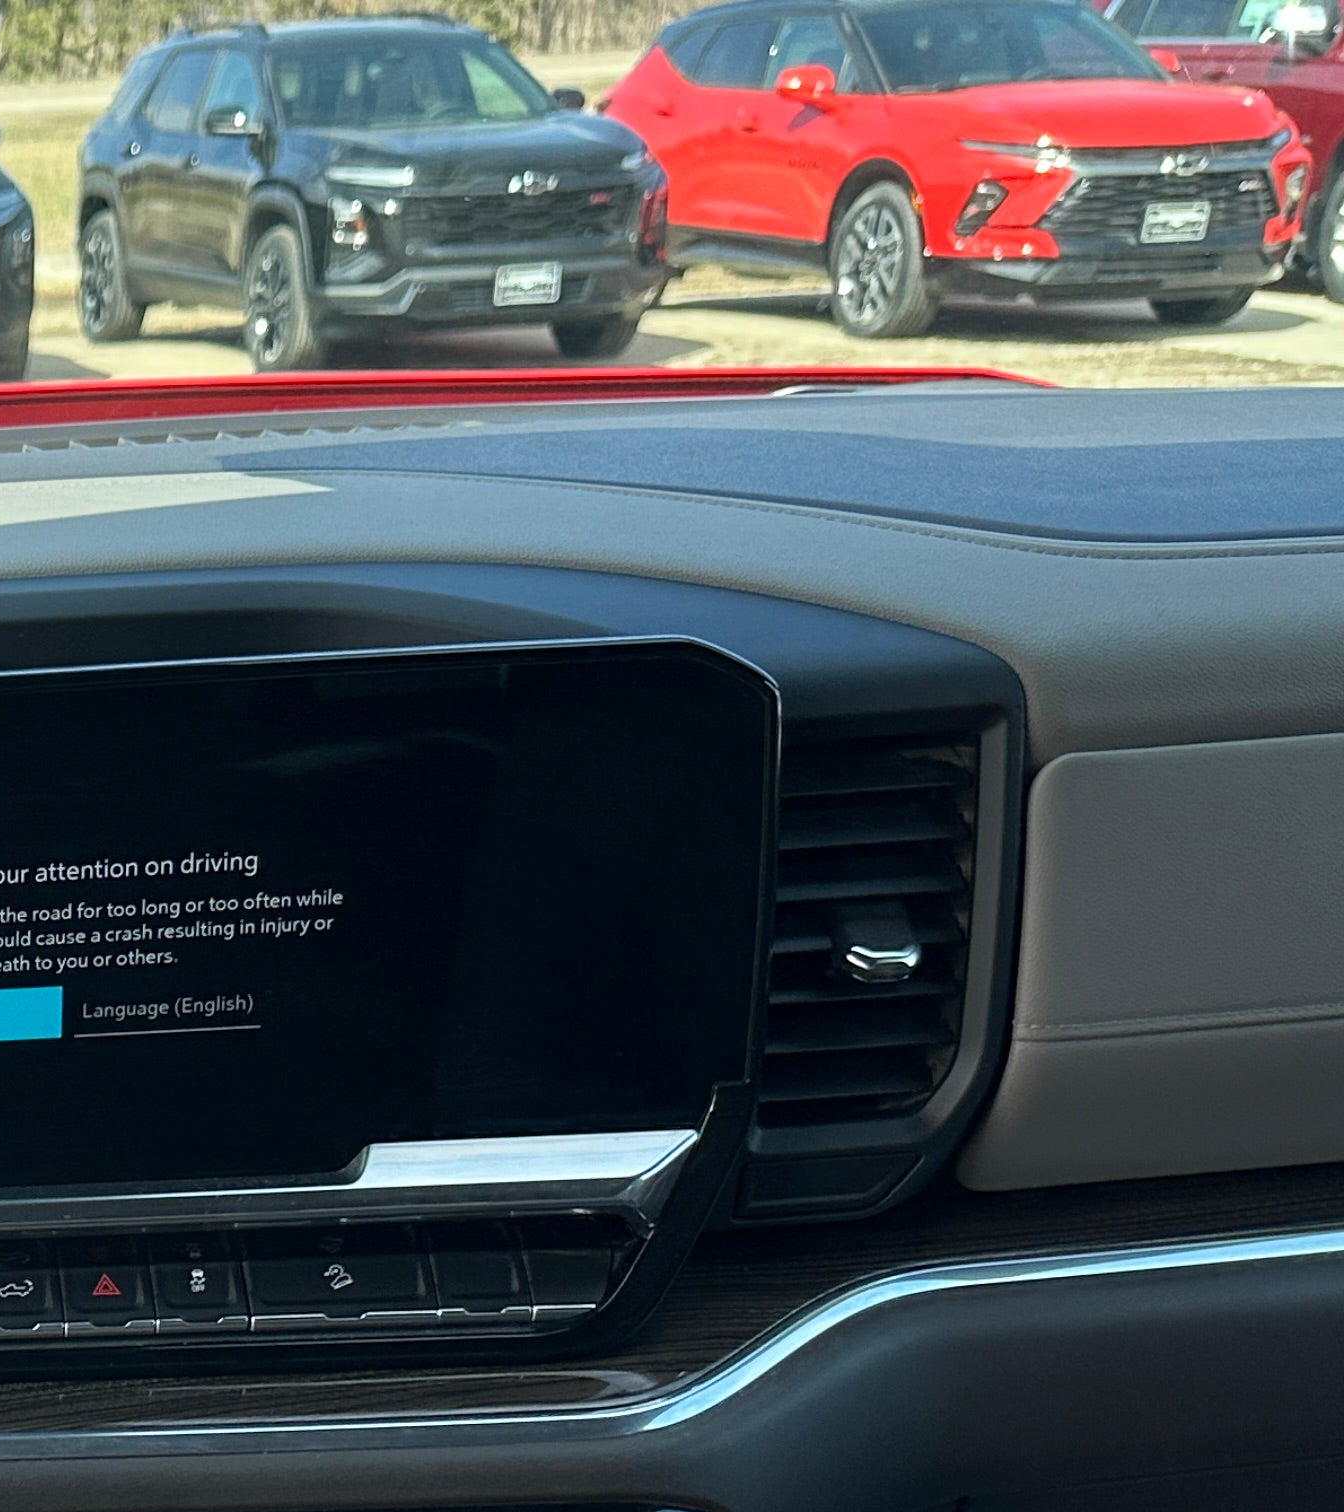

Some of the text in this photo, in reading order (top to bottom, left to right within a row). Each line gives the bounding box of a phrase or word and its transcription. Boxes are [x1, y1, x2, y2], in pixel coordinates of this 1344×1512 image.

[34, 858, 138, 883] attention
[144, 858, 174, 876] on
[180, 852, 259, 877] driving
[0, 906, 28, 924] the
[31, 903, 72, 922] road
[76, 902, 103, 919] for
[106, 902, 137, 918] too
[141, 899, 181, 919] long
[185, 900, 205, 913] or
[208, 896, 239, 912] too
[243, 891, 292, 910] often
[296, 888, 344, 907] while
[35, 930, 87, 947] cause
[90, 930, 101, 944] a
[104, 923, 153, 943] crash
[157, 920, 235, 941] resulting
[239, 918, 256, 936] in
[260, 917, 311, 938] injury
[314, 917, 334, 931] or
[34, 954, 53, 972] to
[55, 954, 89, 975] you
[92, 953, 113, 967] or
[116, 948, 179, 967] others.
[82, 993, 254, 1022] Language (English)
